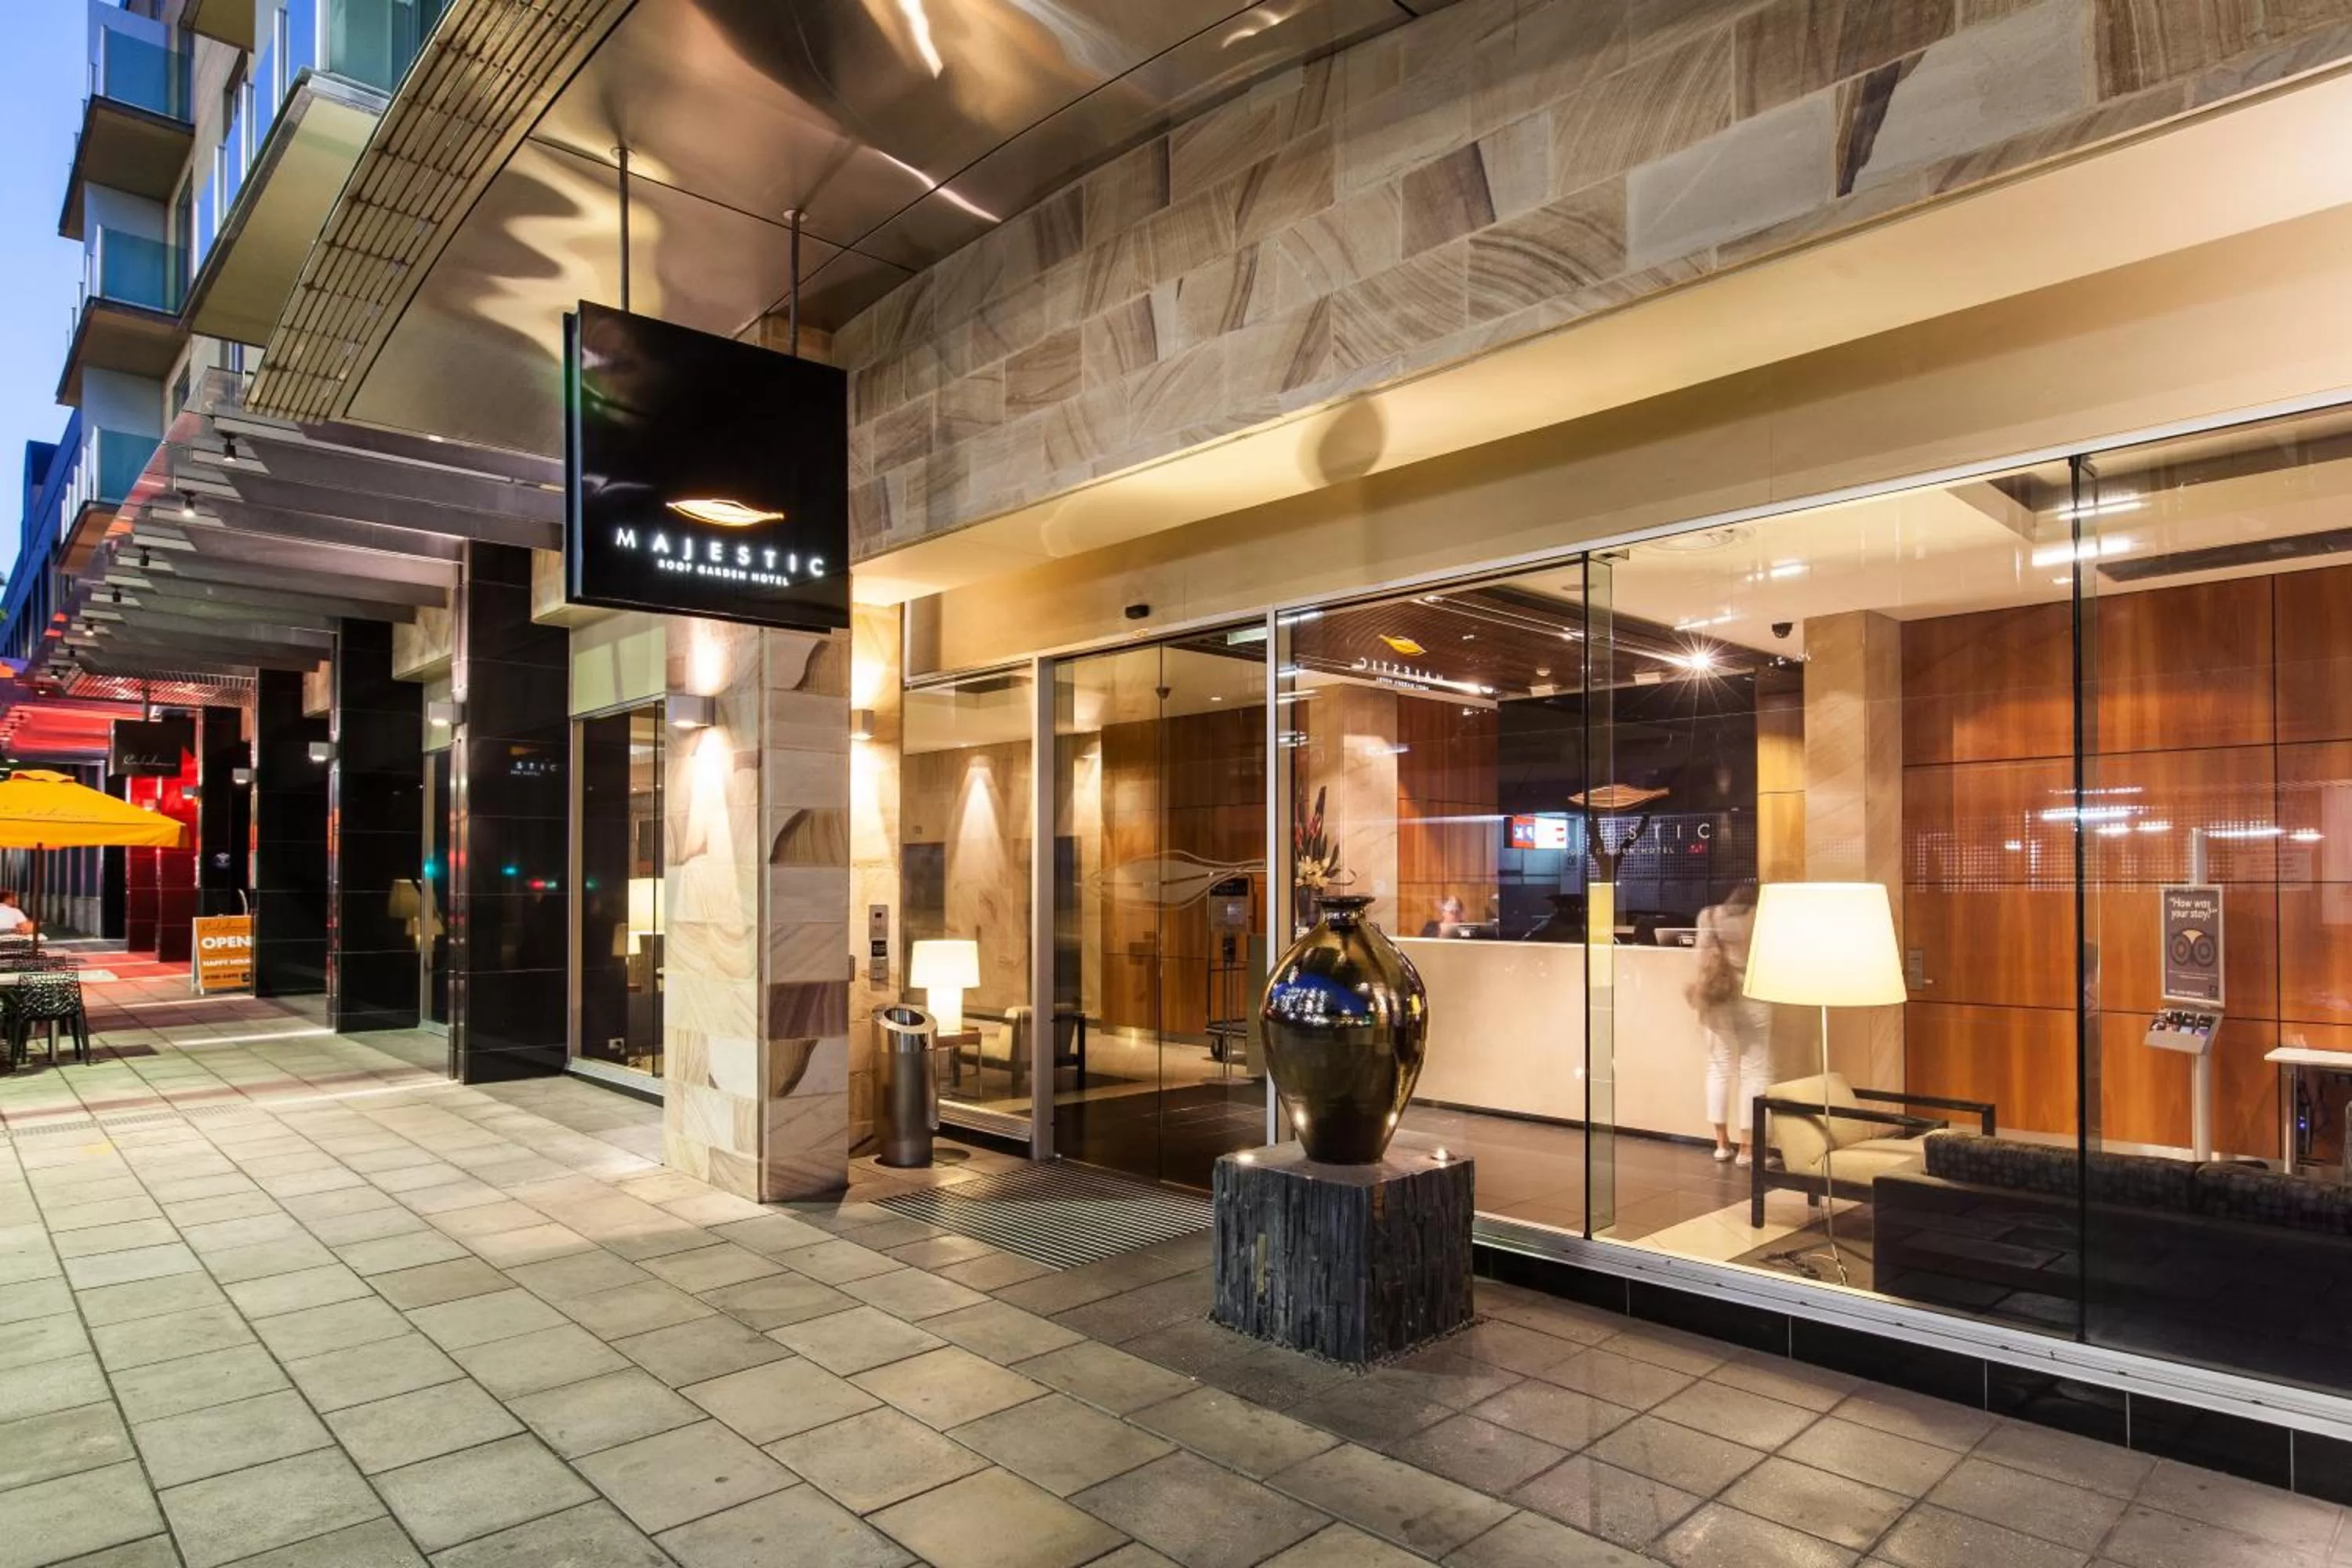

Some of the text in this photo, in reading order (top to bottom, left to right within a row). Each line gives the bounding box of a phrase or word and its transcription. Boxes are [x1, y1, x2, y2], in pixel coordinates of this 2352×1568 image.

[615, 528, 825, 577] MAJESTIC
[657, 559, 789, 586] ROOF GARDEN HOTEL
[201, 935, 252, 949] OPEN
